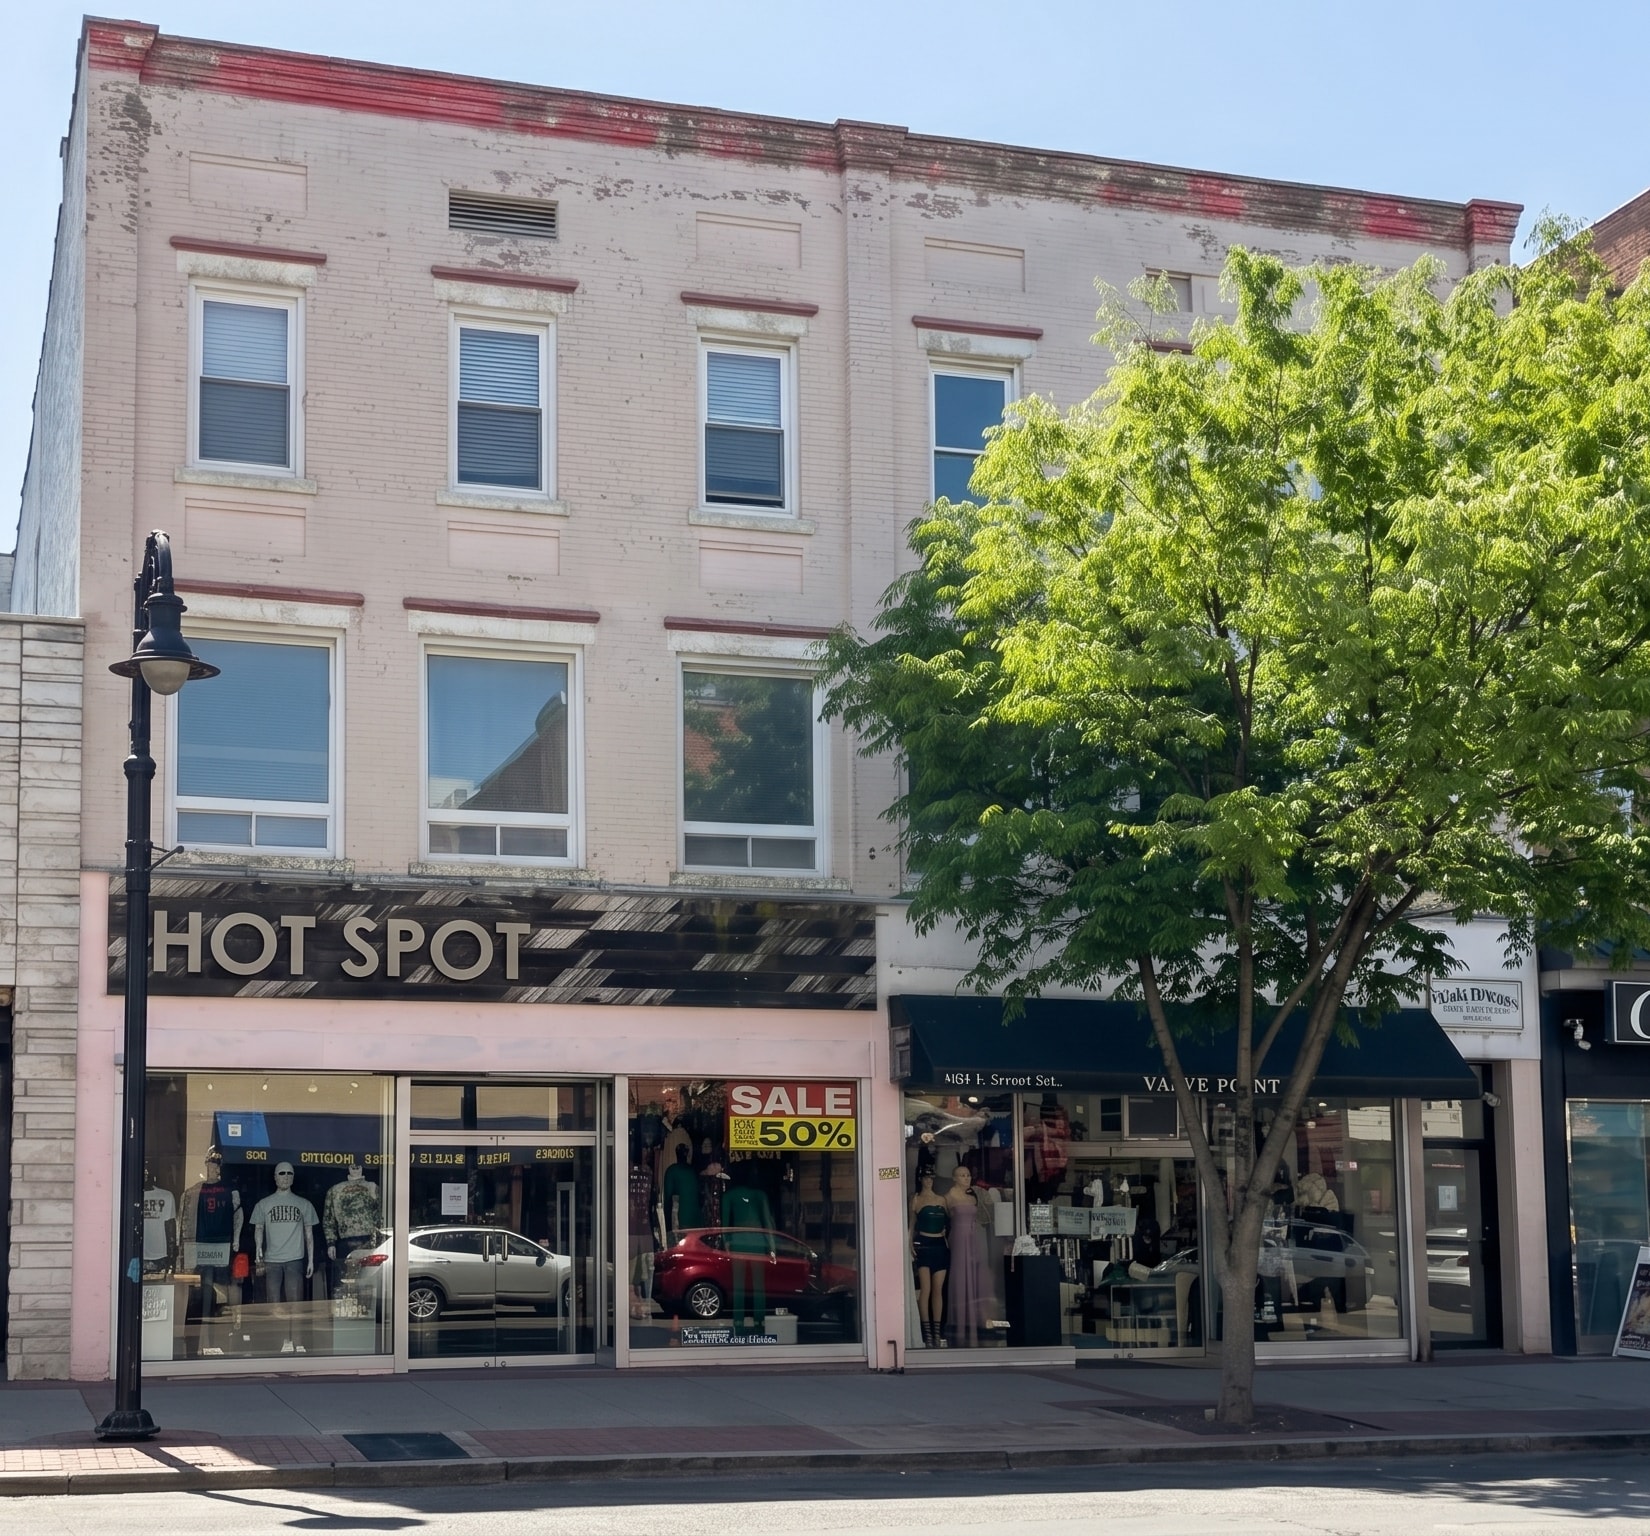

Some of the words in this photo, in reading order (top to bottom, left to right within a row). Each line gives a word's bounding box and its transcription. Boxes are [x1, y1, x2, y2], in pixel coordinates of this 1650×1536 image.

[153, 910, 316, 975] HOT
[341, 917, 531, 981] SPOT
[730, 1085, 852, 1116] SALE
[759, 1120, 852, 1147] 50%
